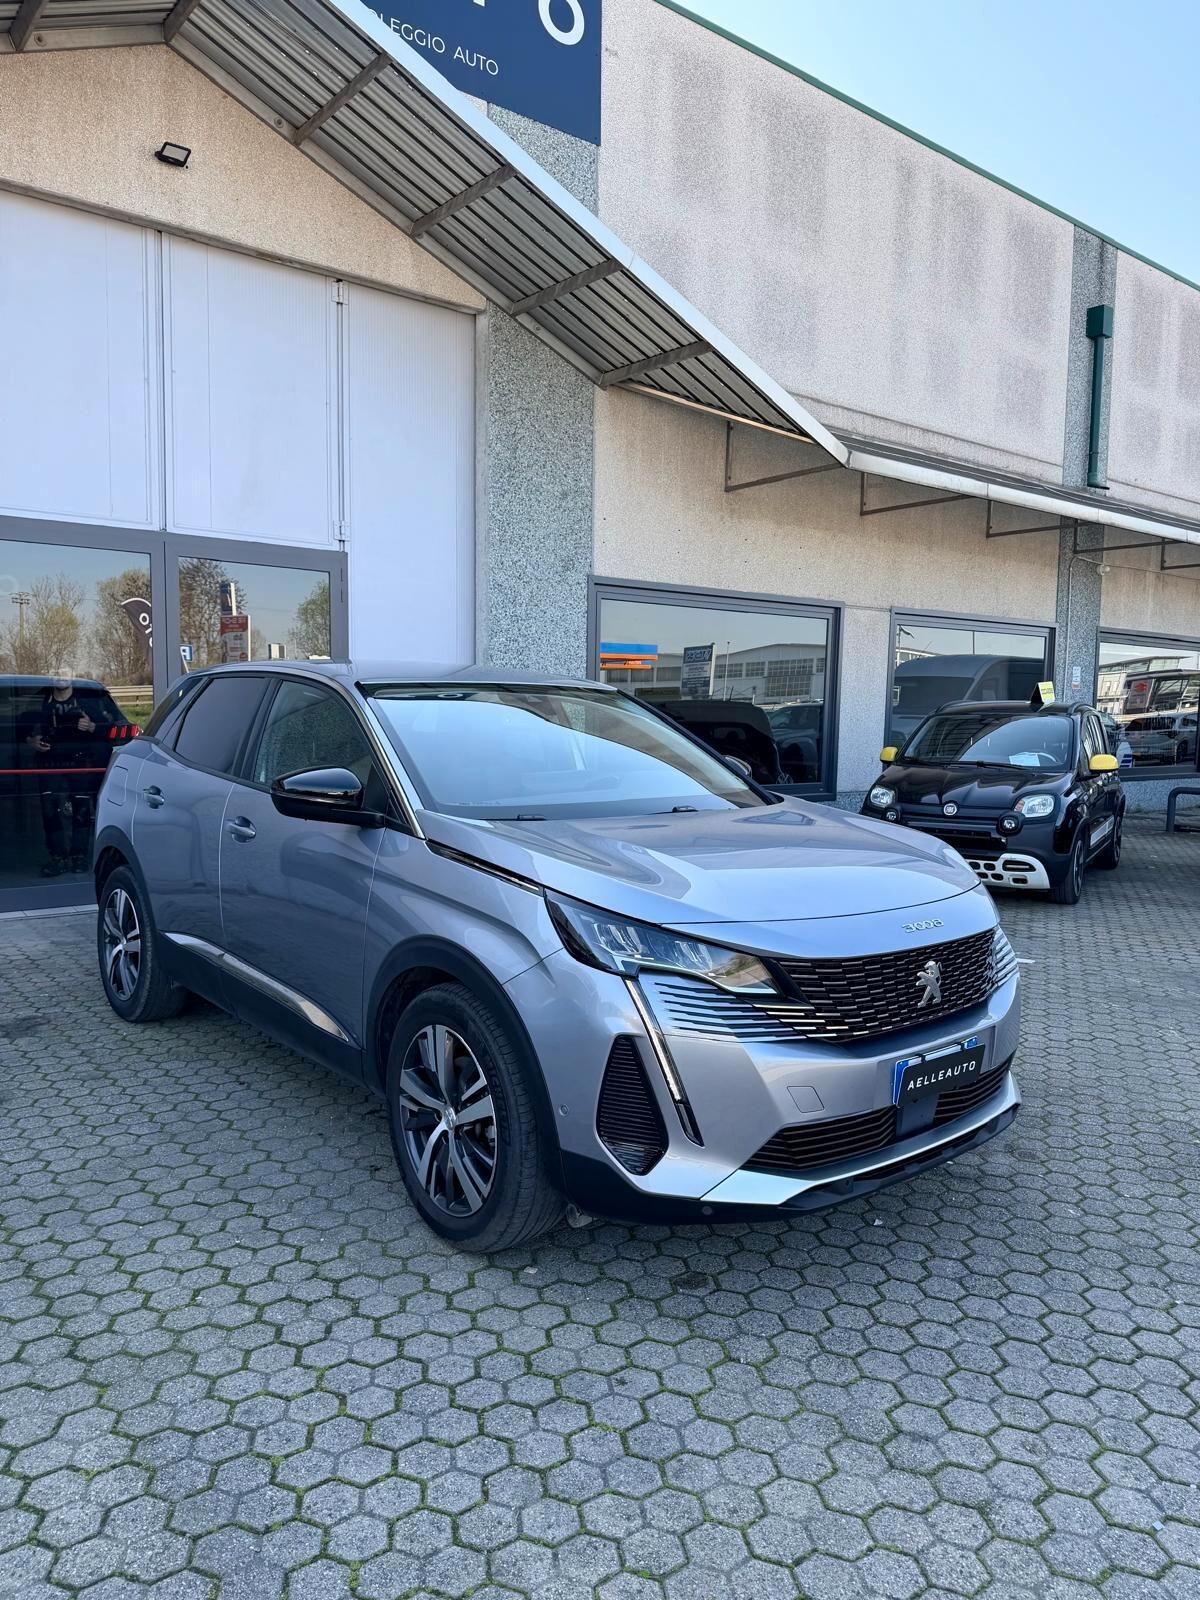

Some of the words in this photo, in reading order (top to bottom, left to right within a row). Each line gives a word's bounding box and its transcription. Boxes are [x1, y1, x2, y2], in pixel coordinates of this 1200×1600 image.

[369, 8, 446, 54] EGGIO
[453, 46, 499, 76] AUTO
[907, 1060, 977, 1091] AELLEAUTO
